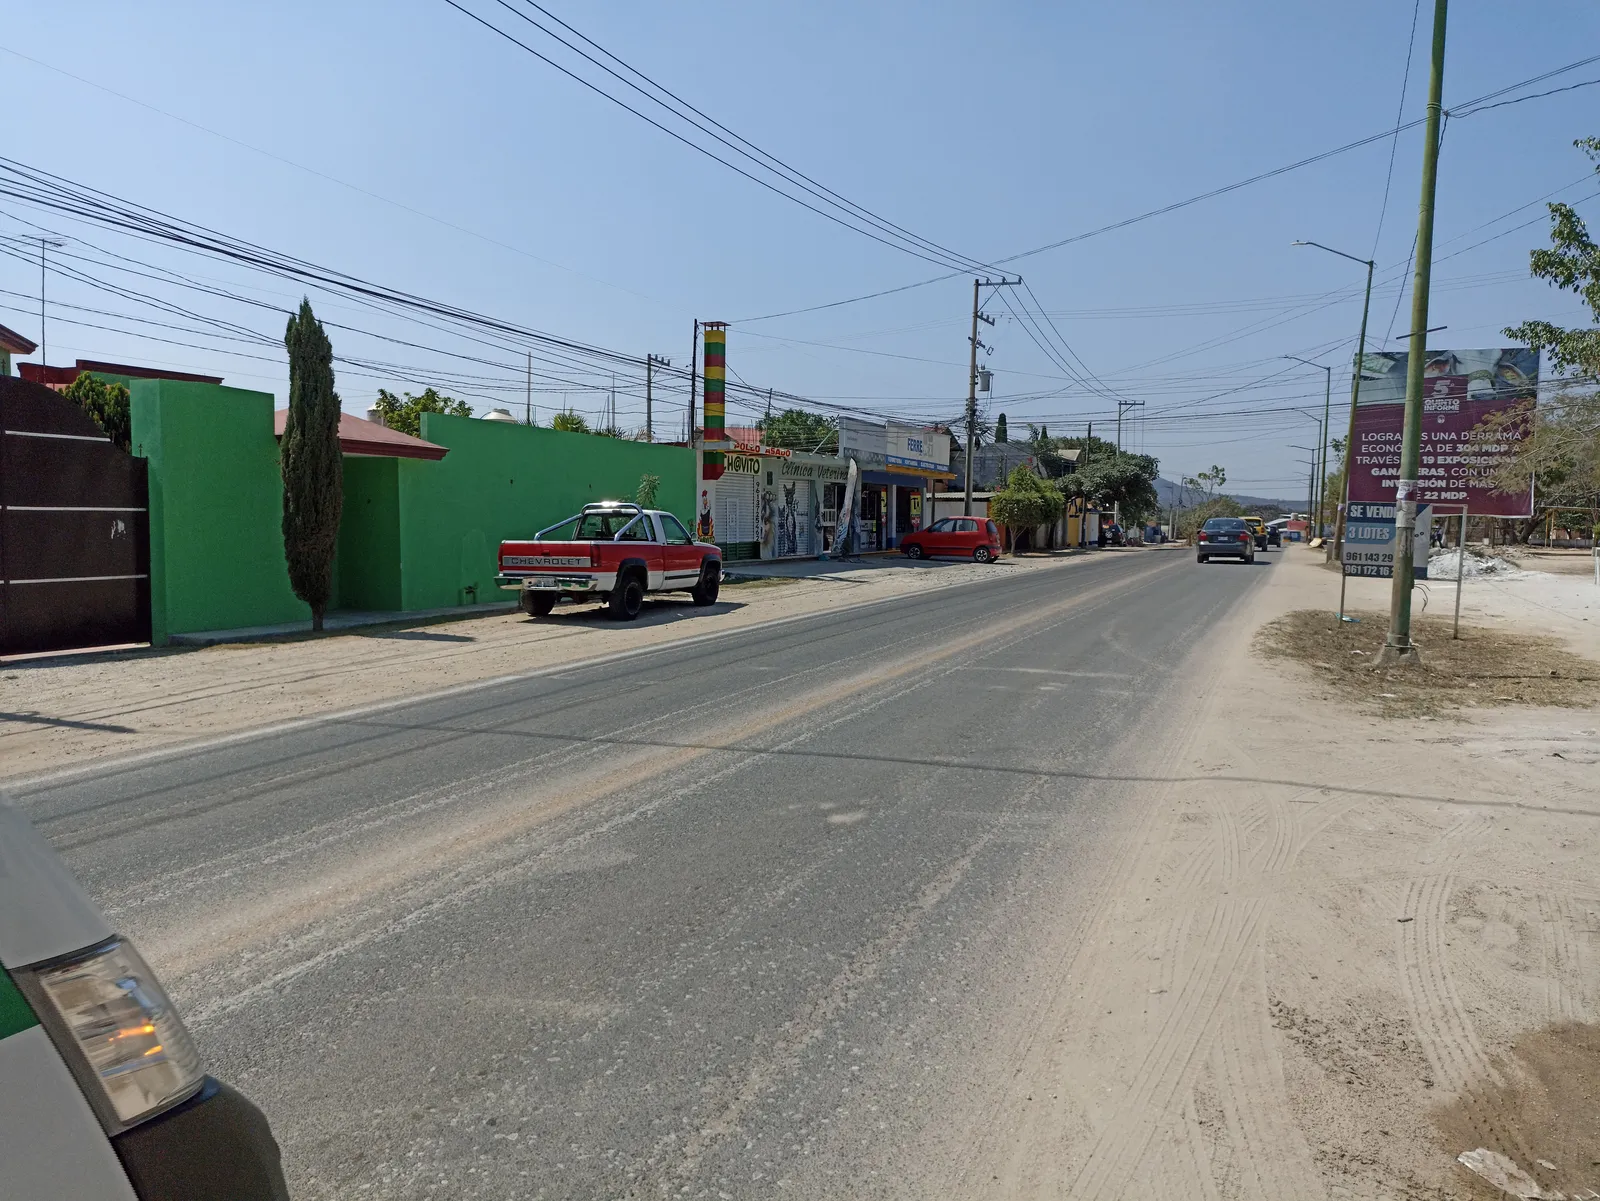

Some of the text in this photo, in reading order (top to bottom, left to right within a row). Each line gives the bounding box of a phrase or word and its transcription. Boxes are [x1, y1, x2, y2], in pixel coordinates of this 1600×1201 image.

[1362, 431, 1522, 441] LOGRAS UNA DERRAMA
[734, 442, 791, 457] POLLO ASADO
[907, 437, 923, 453] FERRE
[1361, 442, 1433, 453] ECONÓCA
[1437, 444, 1453, 452] DE
[1456, 444, 1479, 452] 304
[1481, 444, 1508, 452] MDP
[1356, 454, 1400, 465] TRAVÉS
[1422, 456, 1435, 464] 19
[1371, 467, 1448, 477] GANAERAS,
[1451, 467, 1478, 476] CON
[1382, 477, 1446, 488] INVSIÓN
[1450, 479, 1466, 488] DE
[1424, 491, 1439, 500] 22
[1441, 491, 1470, 500] MDP.
[1350, 505, 1364, 518] SE
[1349, 526, 1390, 540] 3 LOTES
[511, 557, 582, 566] CHEVROLET
[1346, 552, 1394, 563] 961 143 29
[1345, 565, 1361, 574] 961
[1363, 566, 1377, 575] 172
[1379, 566, 1390, 576] 16
